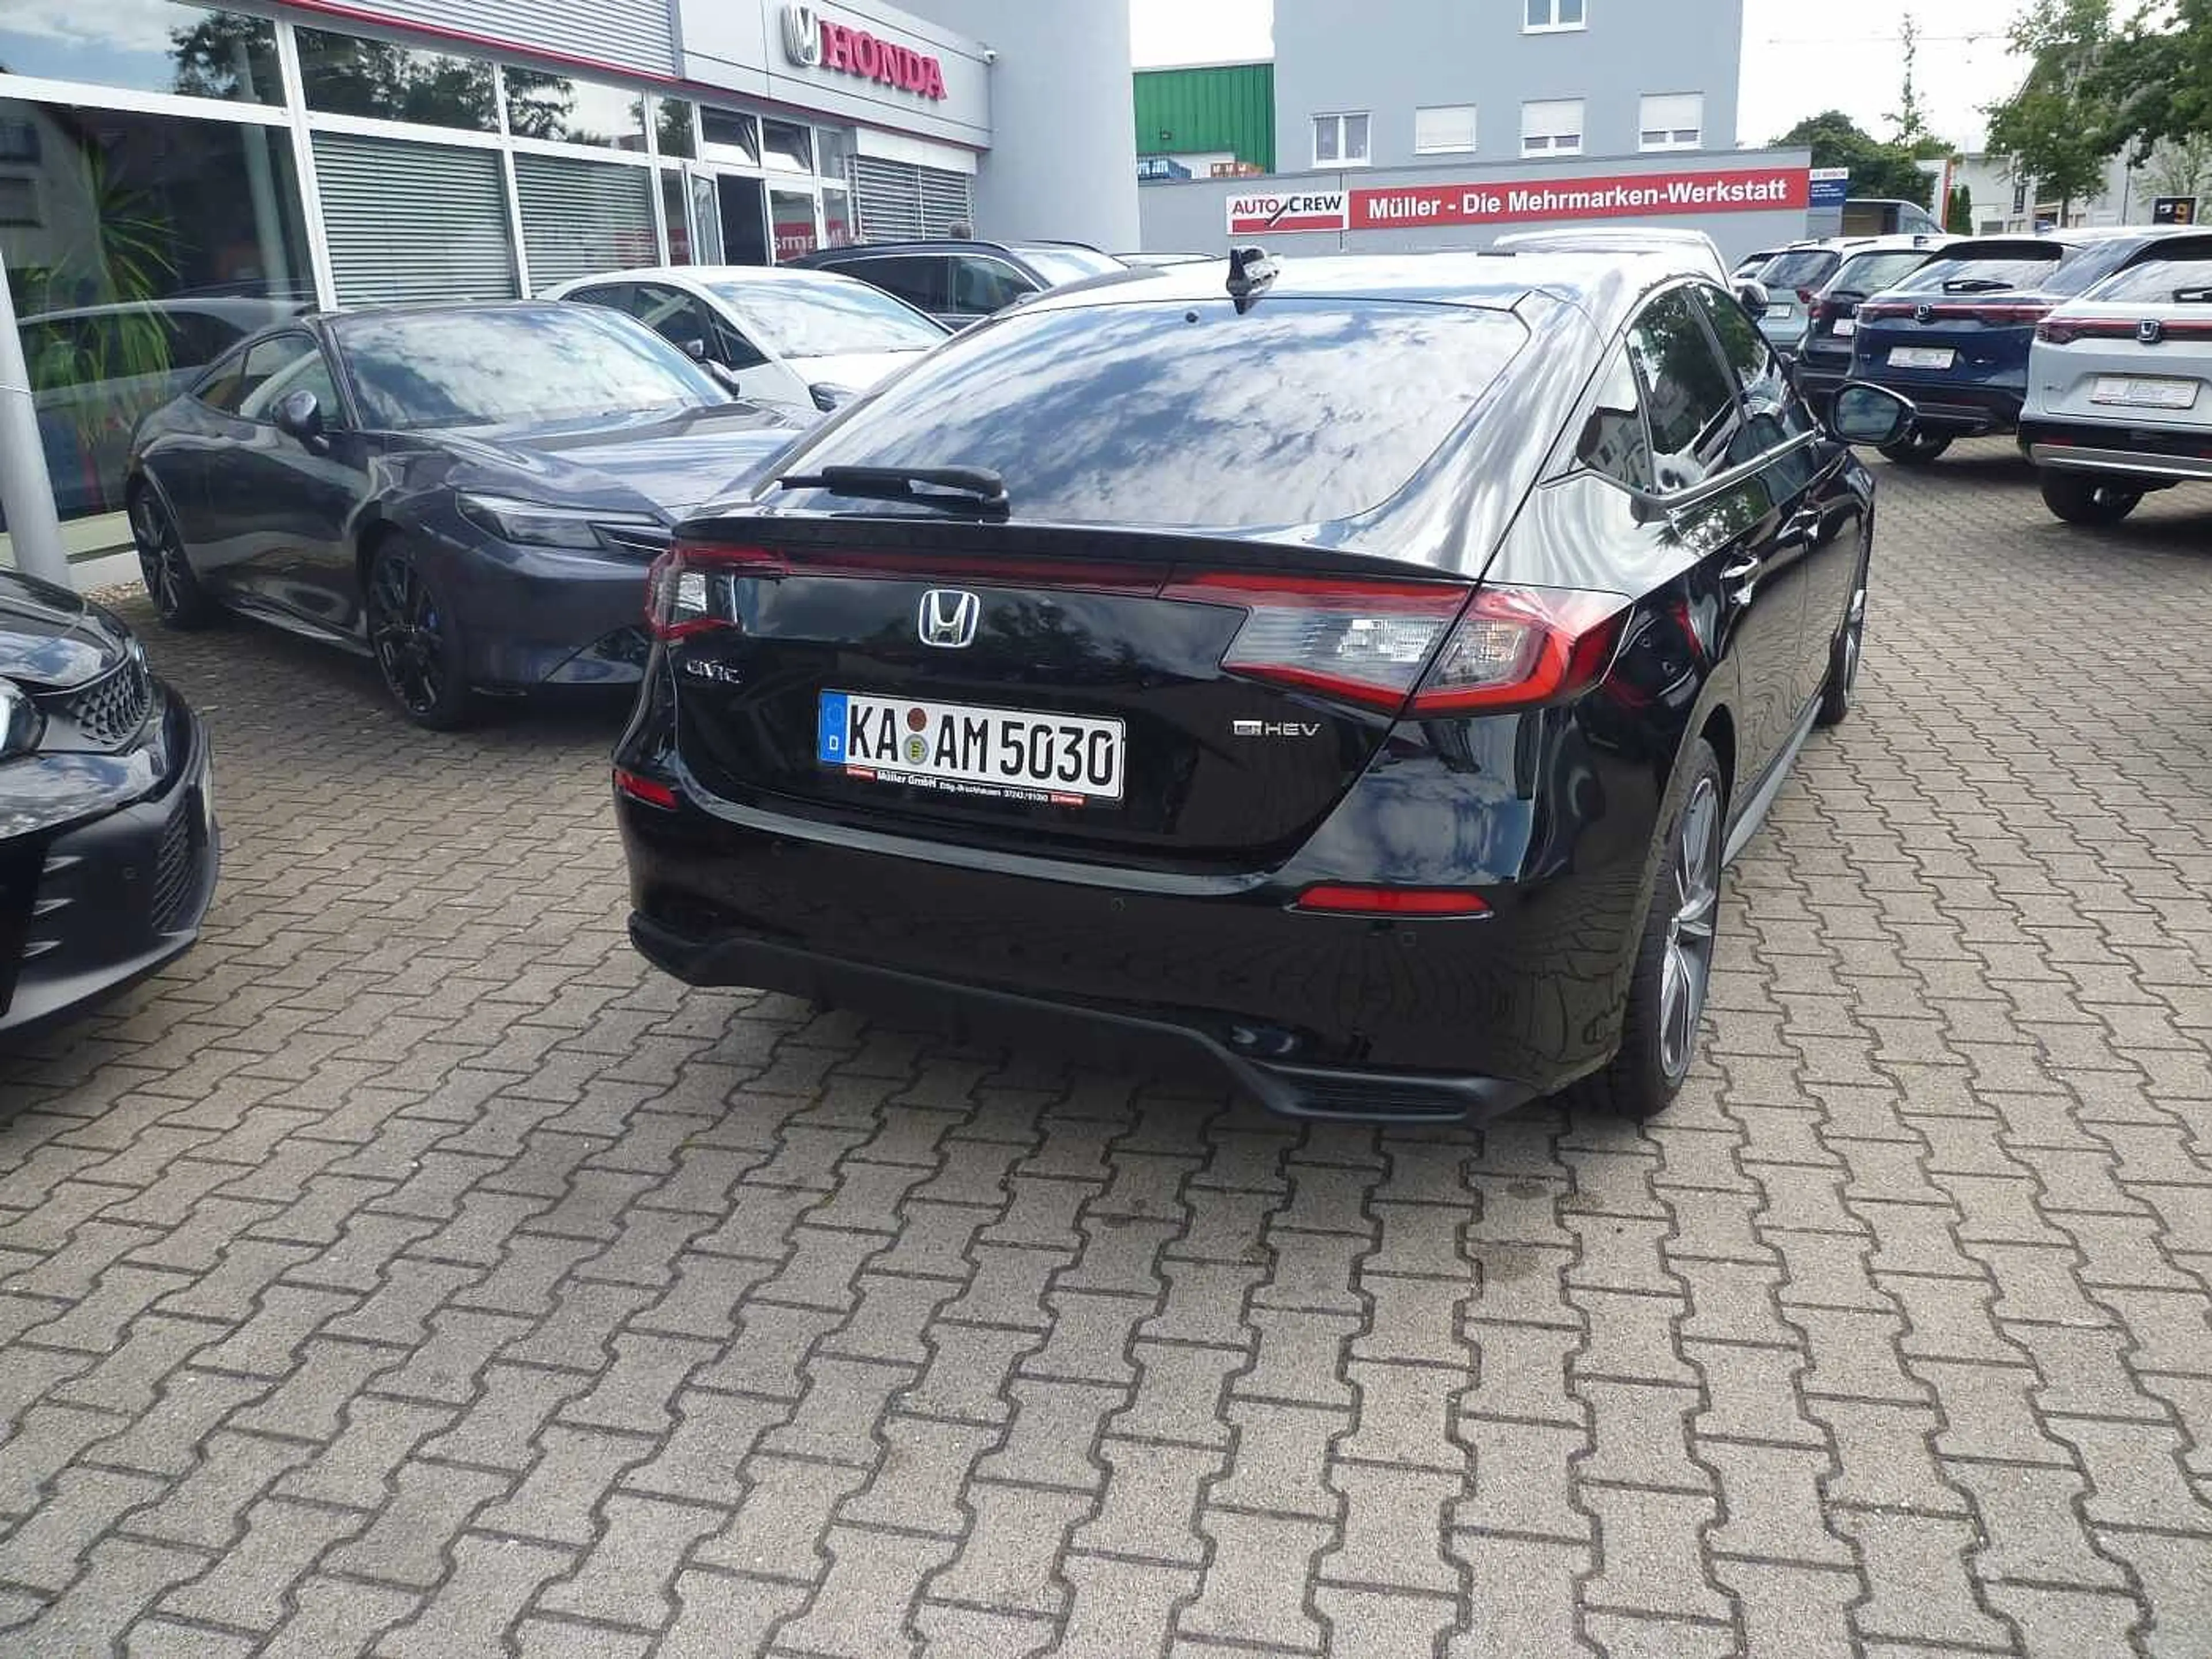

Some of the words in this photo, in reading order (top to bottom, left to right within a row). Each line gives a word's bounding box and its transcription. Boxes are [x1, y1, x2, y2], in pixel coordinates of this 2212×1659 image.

[820, 20, 948, 100] HONDA
[1289, 196, 1342, 211] CREW
[1369, 196, 1441, 219] Müller
[1463, 192, 1499, 214] Die
[1509, 179, 1786, 211] Mehrmarken-Werkstatt
[849, 704, 898, 762] KA
[934, 714, 988, 773] AM
[1000, 720, 1114, 786] 5030
